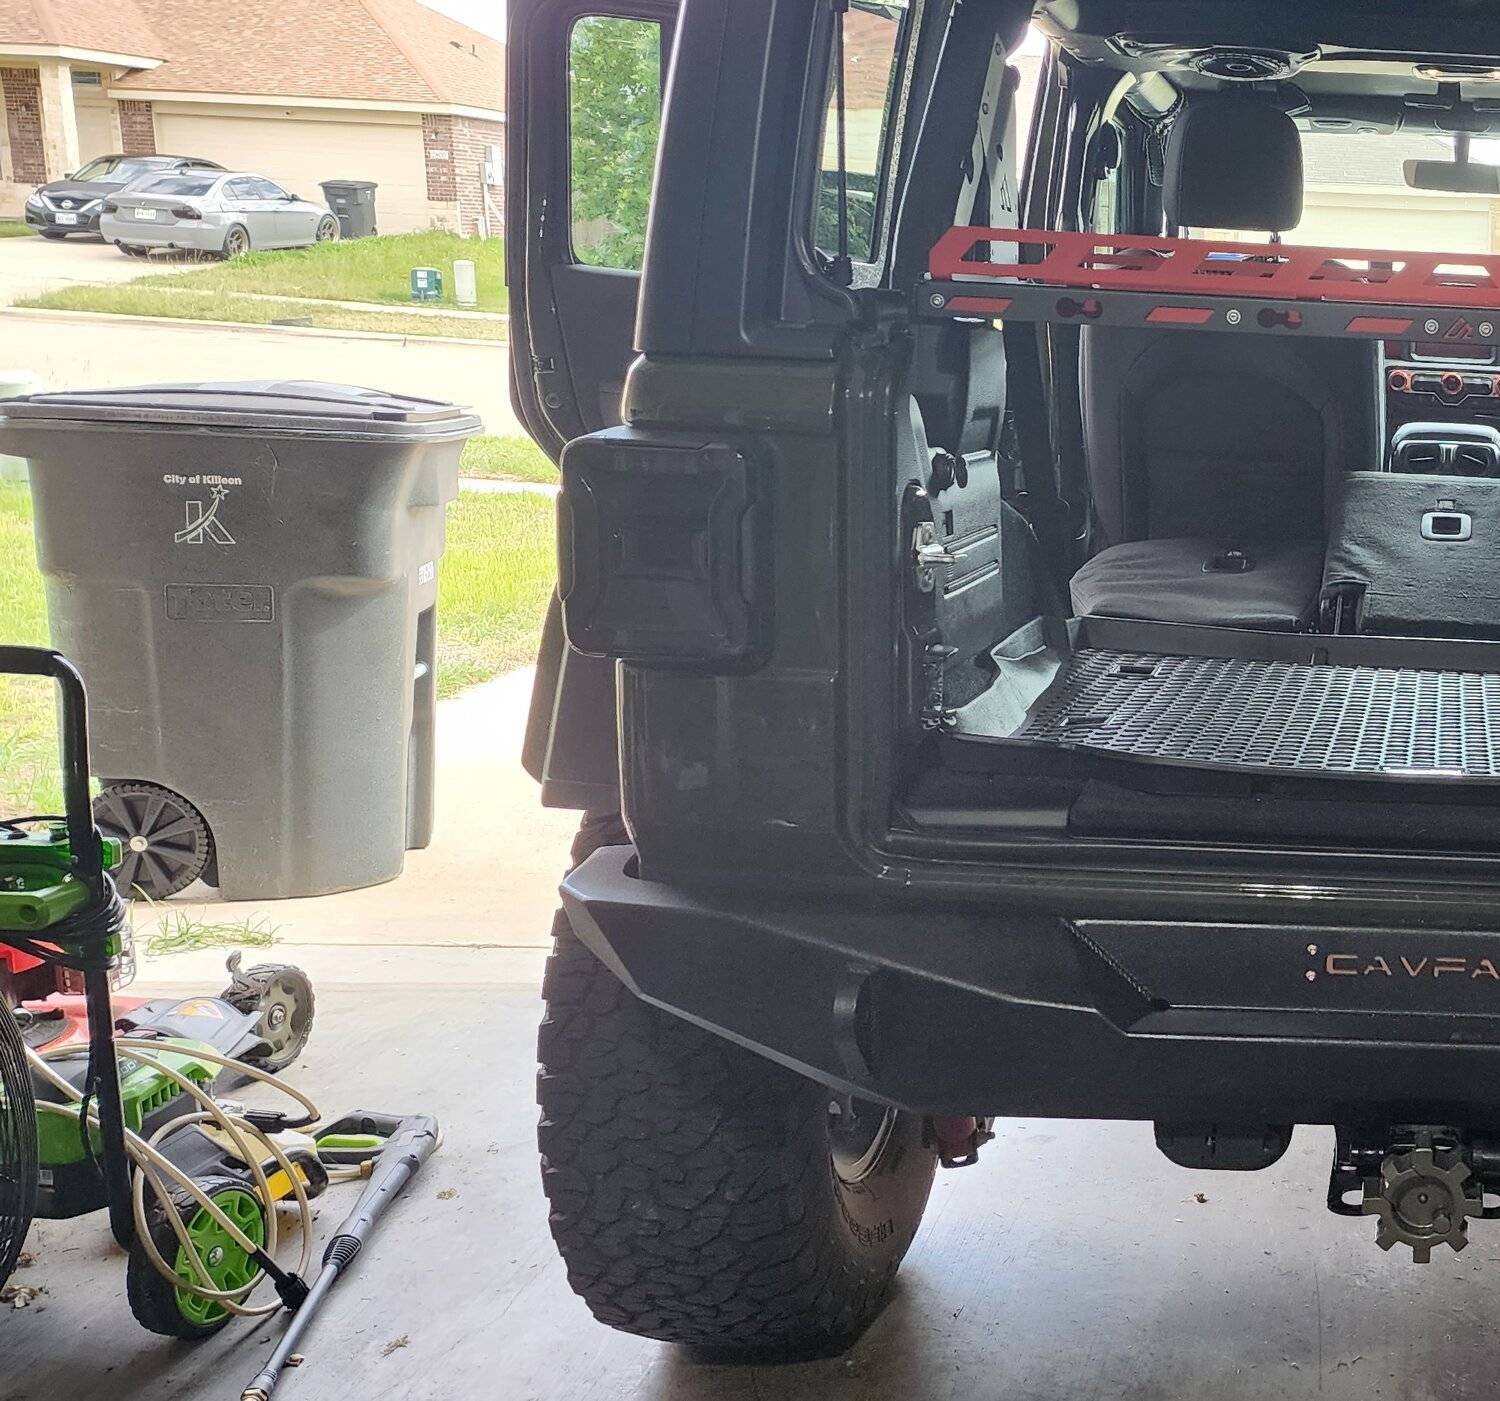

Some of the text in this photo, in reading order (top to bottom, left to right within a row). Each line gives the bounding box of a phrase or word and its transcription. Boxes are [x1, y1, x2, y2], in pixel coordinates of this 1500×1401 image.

[163, 474, 242, 485] City of Killeen
